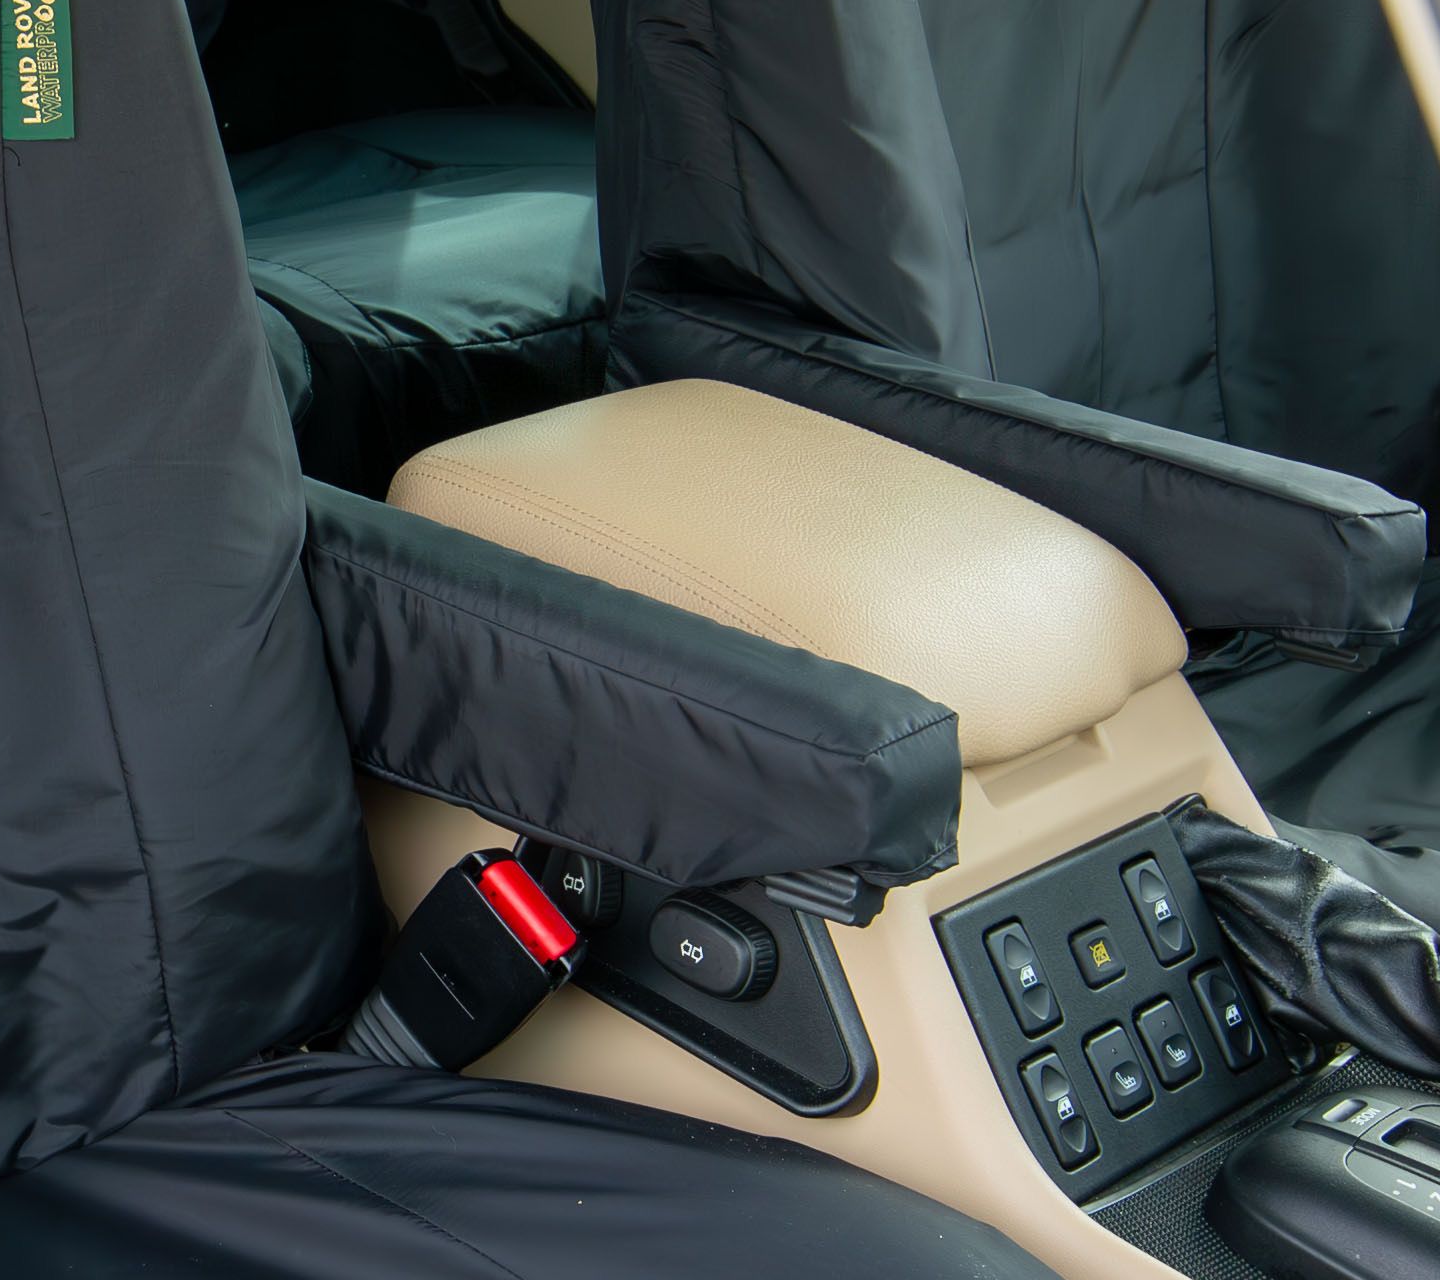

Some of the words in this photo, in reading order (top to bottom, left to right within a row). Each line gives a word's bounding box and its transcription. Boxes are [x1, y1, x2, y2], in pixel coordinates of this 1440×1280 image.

[18, 56, 42, 124] LAND
[1351, 1107, 1382, 1126] MODE
[1396, 1179, 1417, 1189] 1
